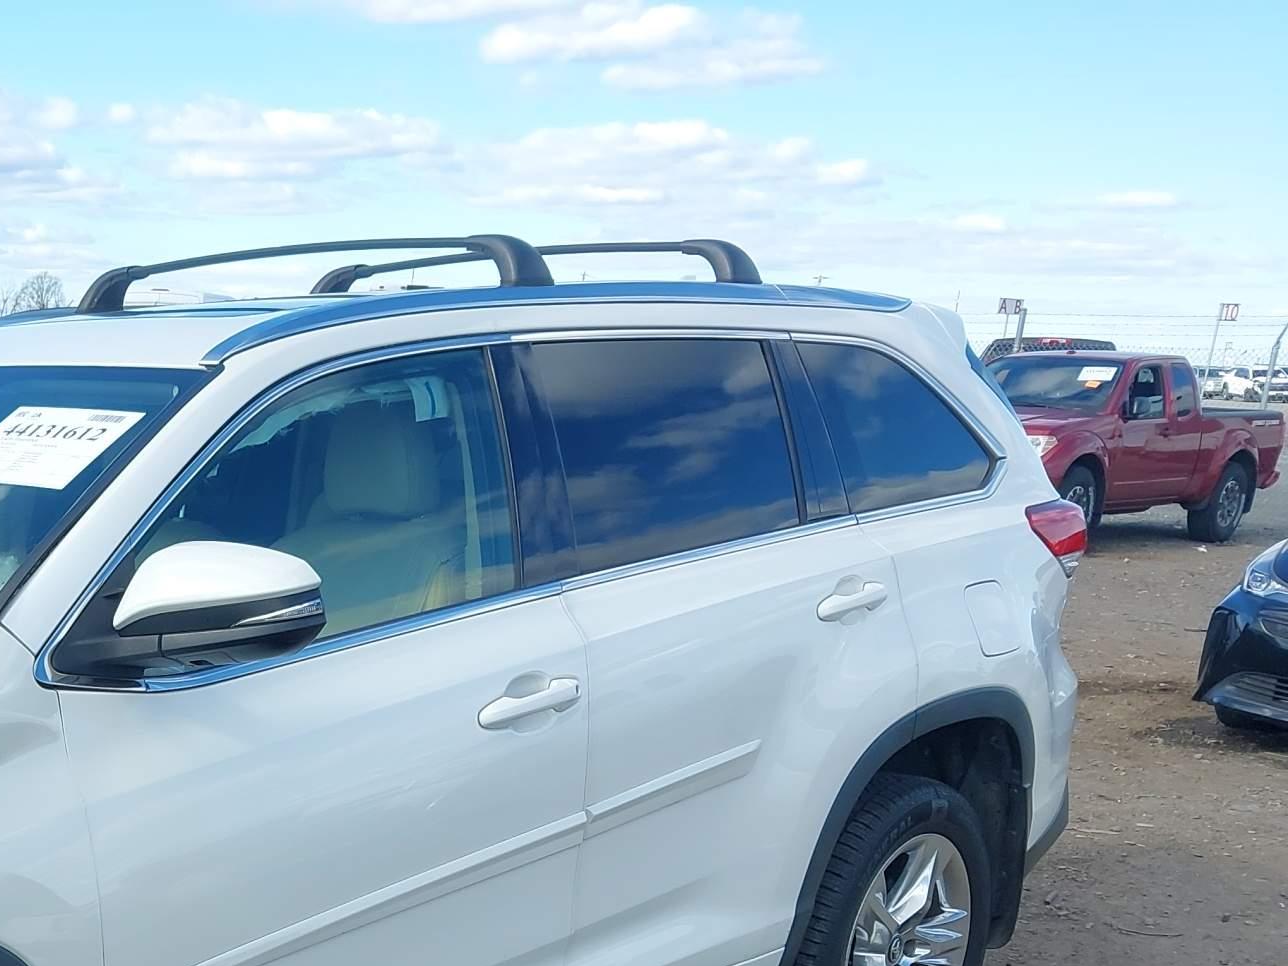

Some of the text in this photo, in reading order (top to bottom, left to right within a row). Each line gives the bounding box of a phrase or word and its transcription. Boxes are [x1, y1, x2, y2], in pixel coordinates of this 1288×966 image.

[998, 298, 1023, 314] A B
[1224, 303, 1239, 321] 10
[3, 423, 107, 441] 44131612
